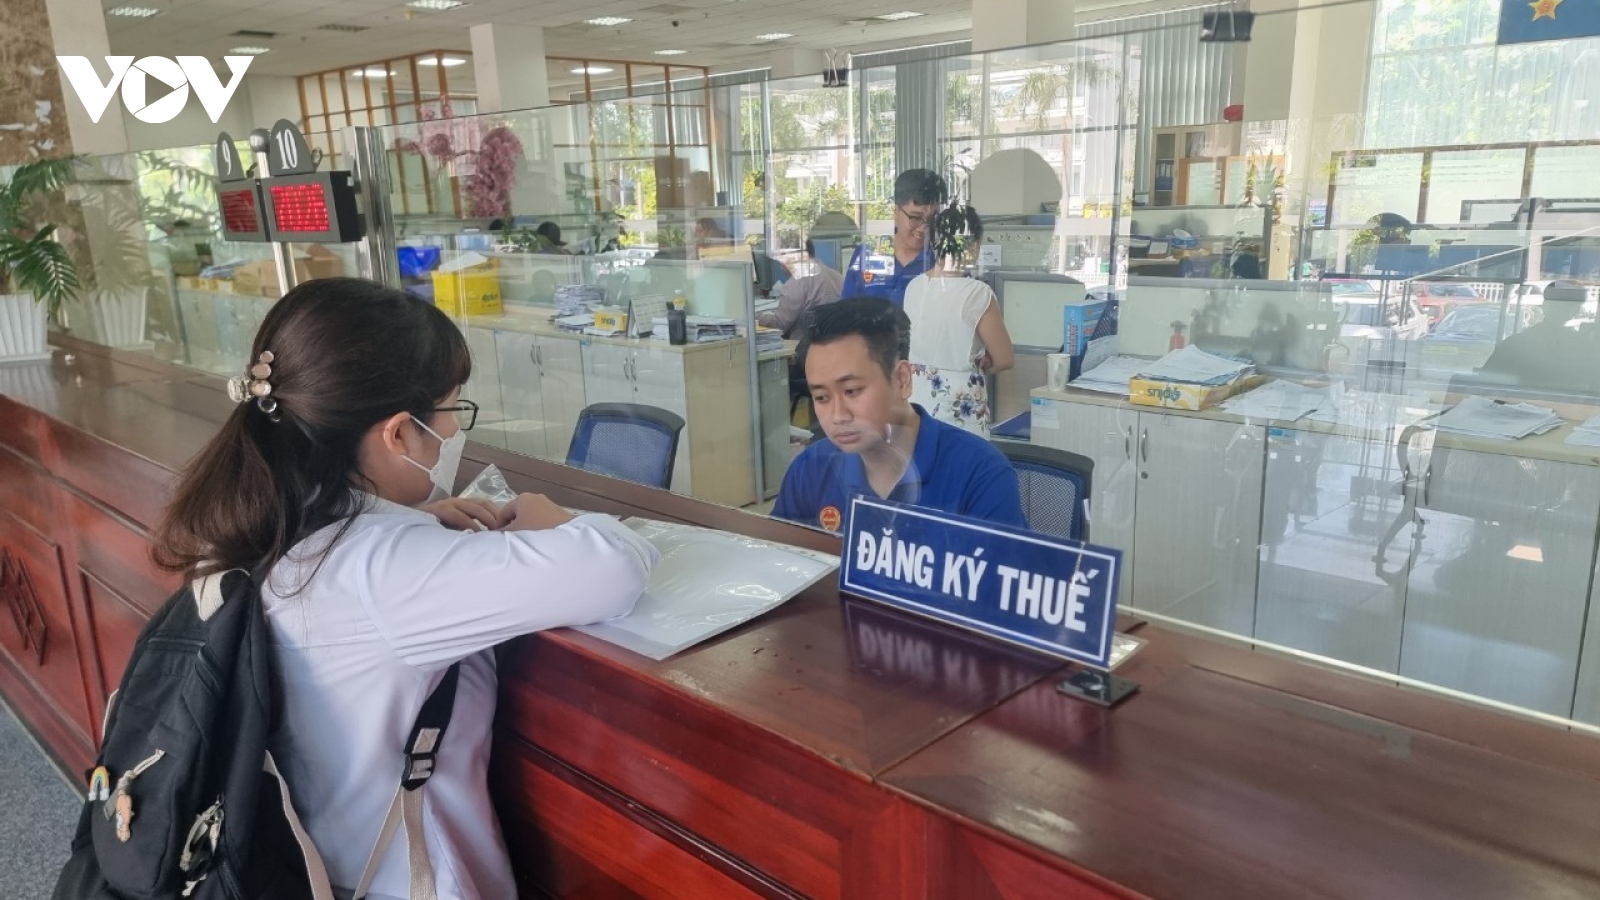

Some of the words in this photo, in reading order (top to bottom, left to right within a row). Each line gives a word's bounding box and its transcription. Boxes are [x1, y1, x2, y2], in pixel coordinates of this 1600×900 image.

[221, 139, 232, 176] 9
[275, 128, 298, 170] 10
[856, 527, 935, 590] ĐĂNG
[941, 547, 987, 602] KÝ
[997, 564, 1099, 633] THUẾ
